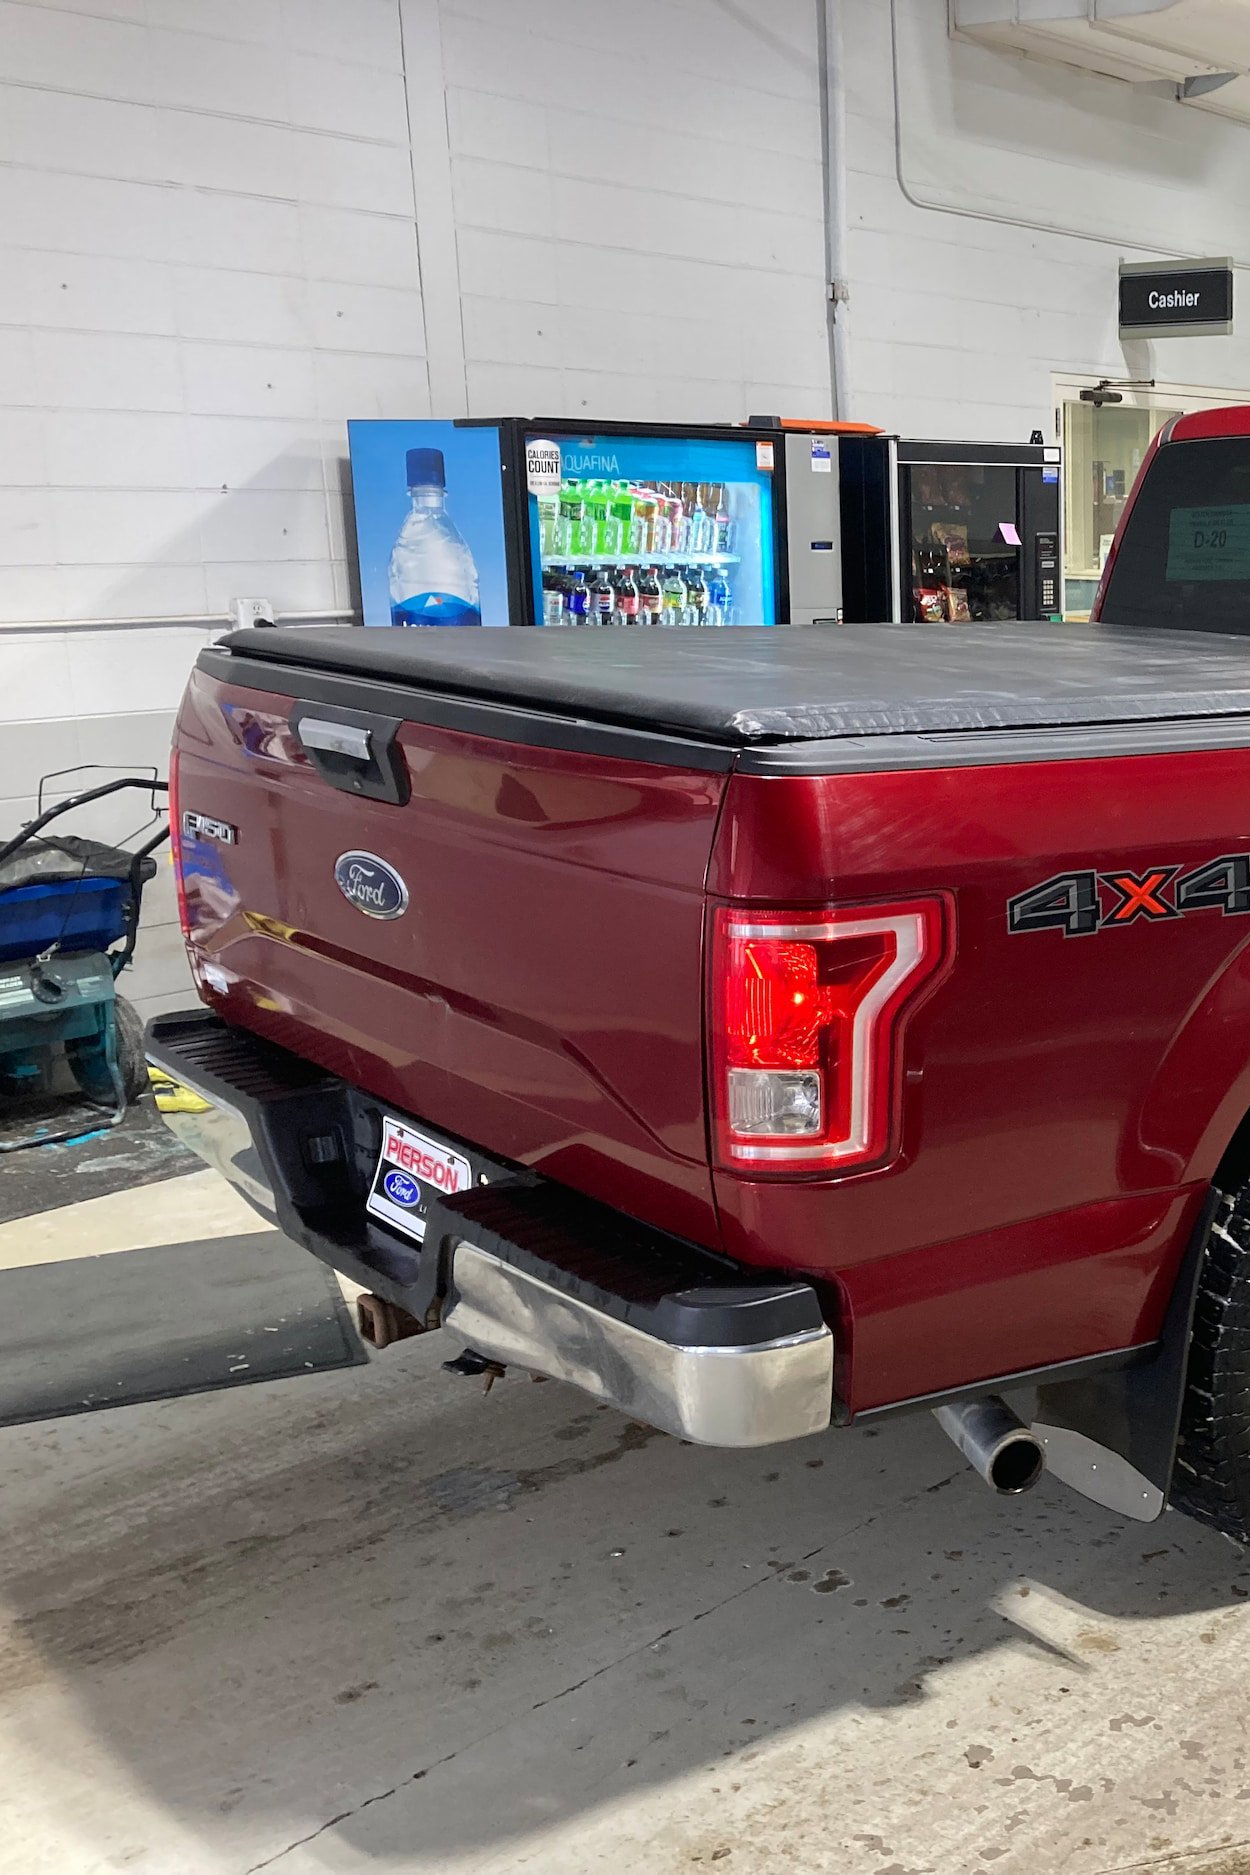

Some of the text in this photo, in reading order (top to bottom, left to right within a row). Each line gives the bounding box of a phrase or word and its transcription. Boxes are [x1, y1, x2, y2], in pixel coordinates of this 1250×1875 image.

[1148, 289, 1200, 309] Cashier
[527, 449, 560, 460] CALORIES
[528, 460, 560, 474] COUNT
[1194, 529, 1227, 548] D-20
[346, 864, 386, 907] Ford
[386, 1134, 460, 1194] PIERSON
[389, 1174, 414, 1202] Ford
